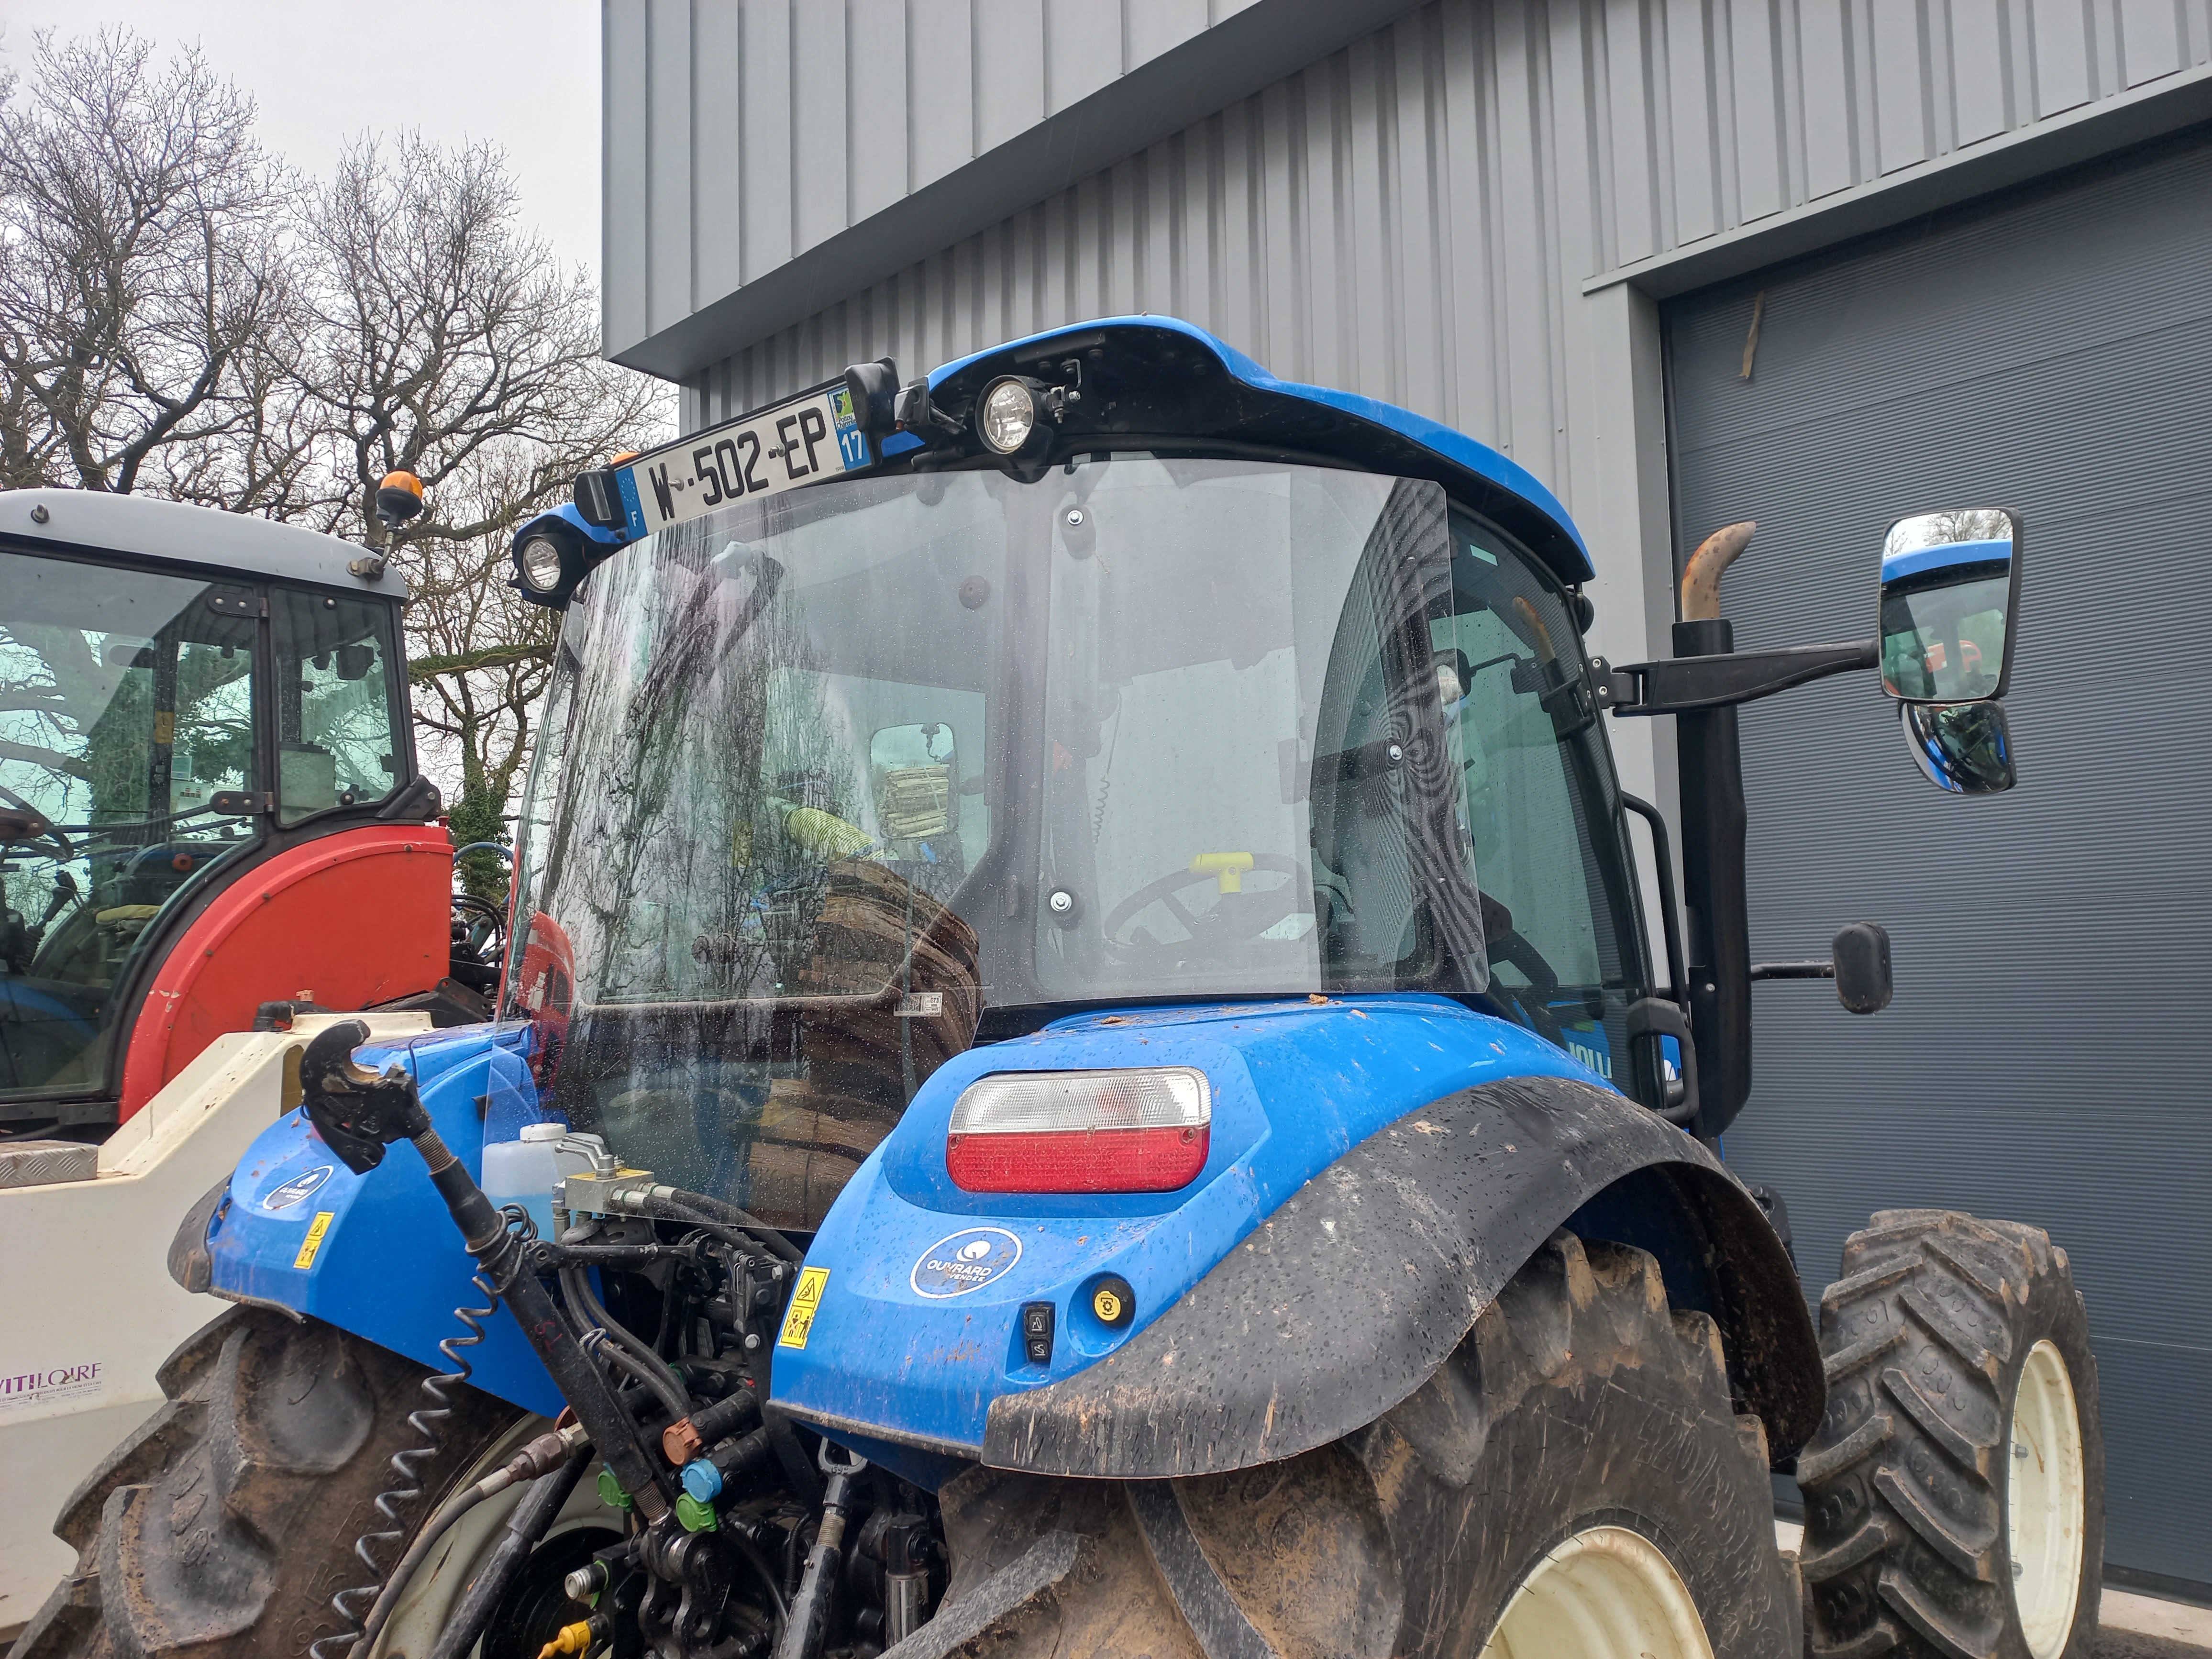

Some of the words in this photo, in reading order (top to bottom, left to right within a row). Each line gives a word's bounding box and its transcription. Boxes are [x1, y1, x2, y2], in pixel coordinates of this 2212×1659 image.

[841, 430, 863, 462] 17
[630, 510, 637, 527] F
[927, 1259, 993, 1276] OUVRARD
